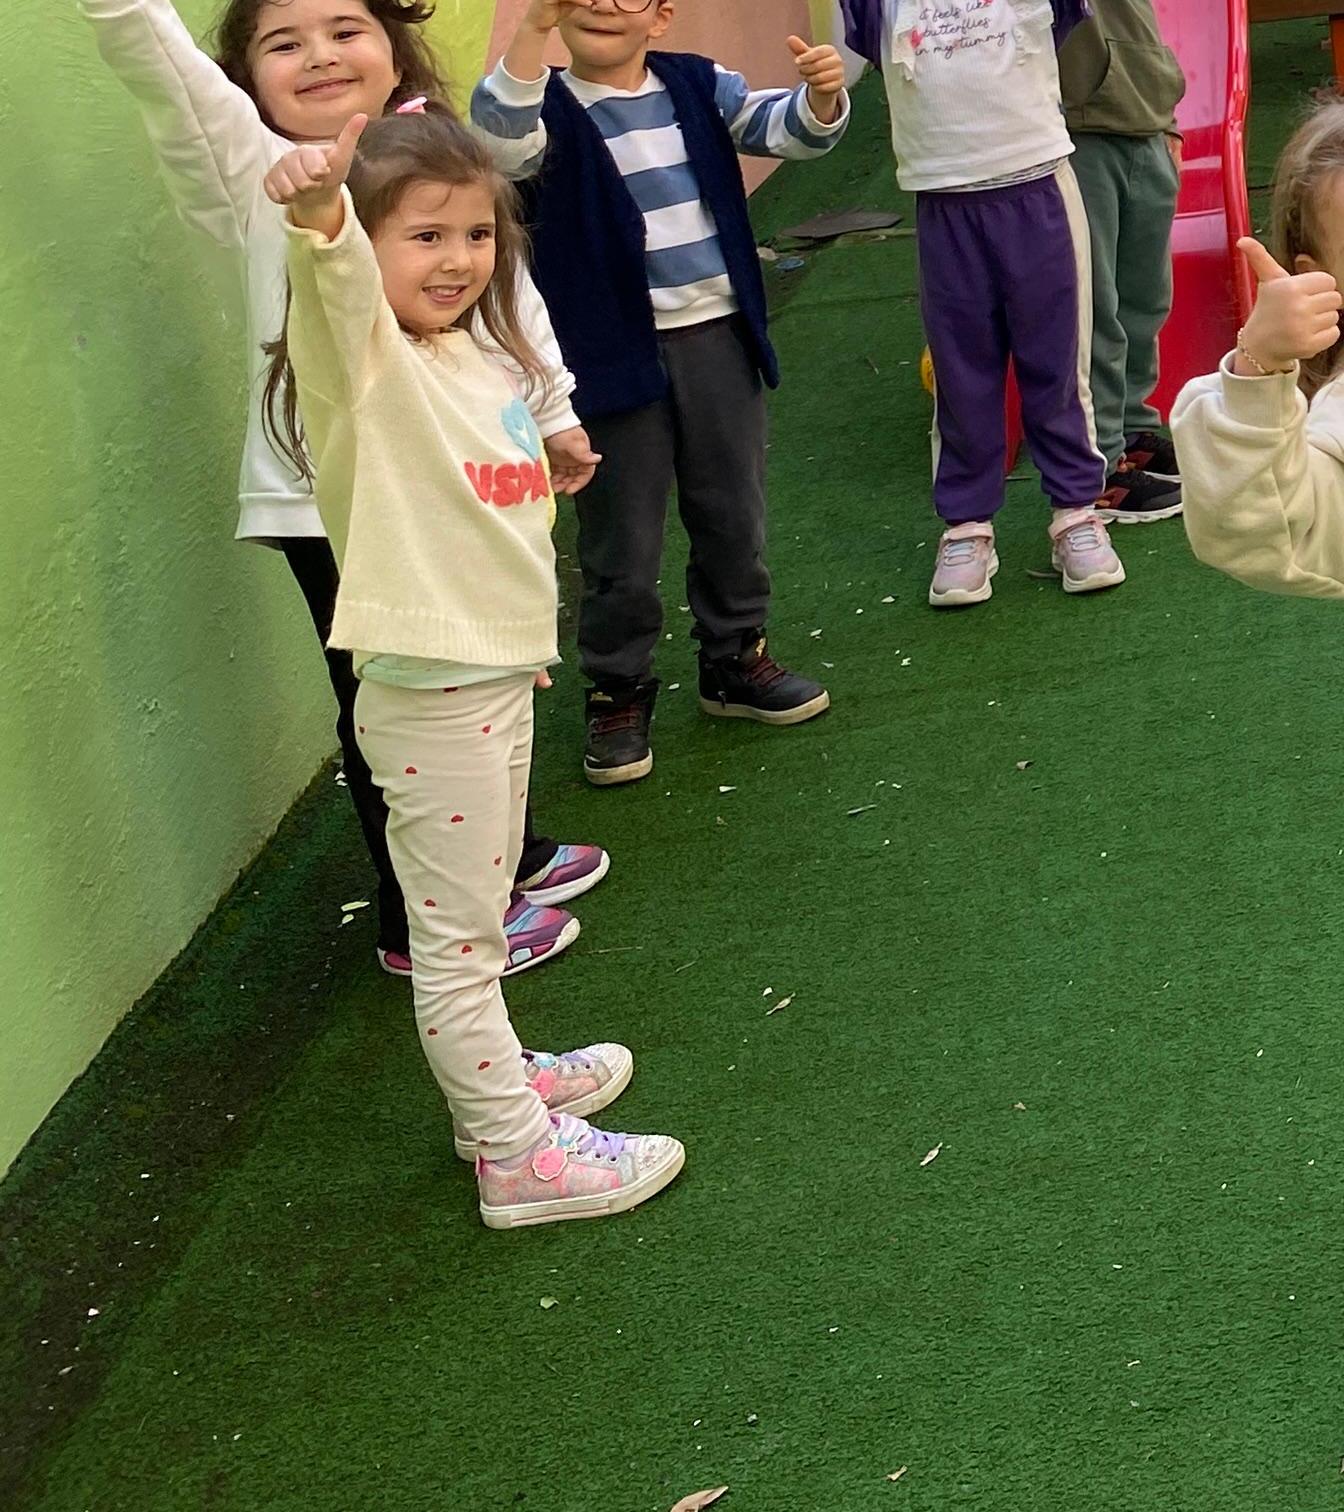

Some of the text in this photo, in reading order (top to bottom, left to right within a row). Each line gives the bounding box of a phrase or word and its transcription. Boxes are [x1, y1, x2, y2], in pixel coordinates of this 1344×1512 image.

[932, 4, 961, 22] feels
[923, 17, 991, 38] butterflies
[933, 45, 955, 60] my
[959, 32, 1007, 49] tummy
